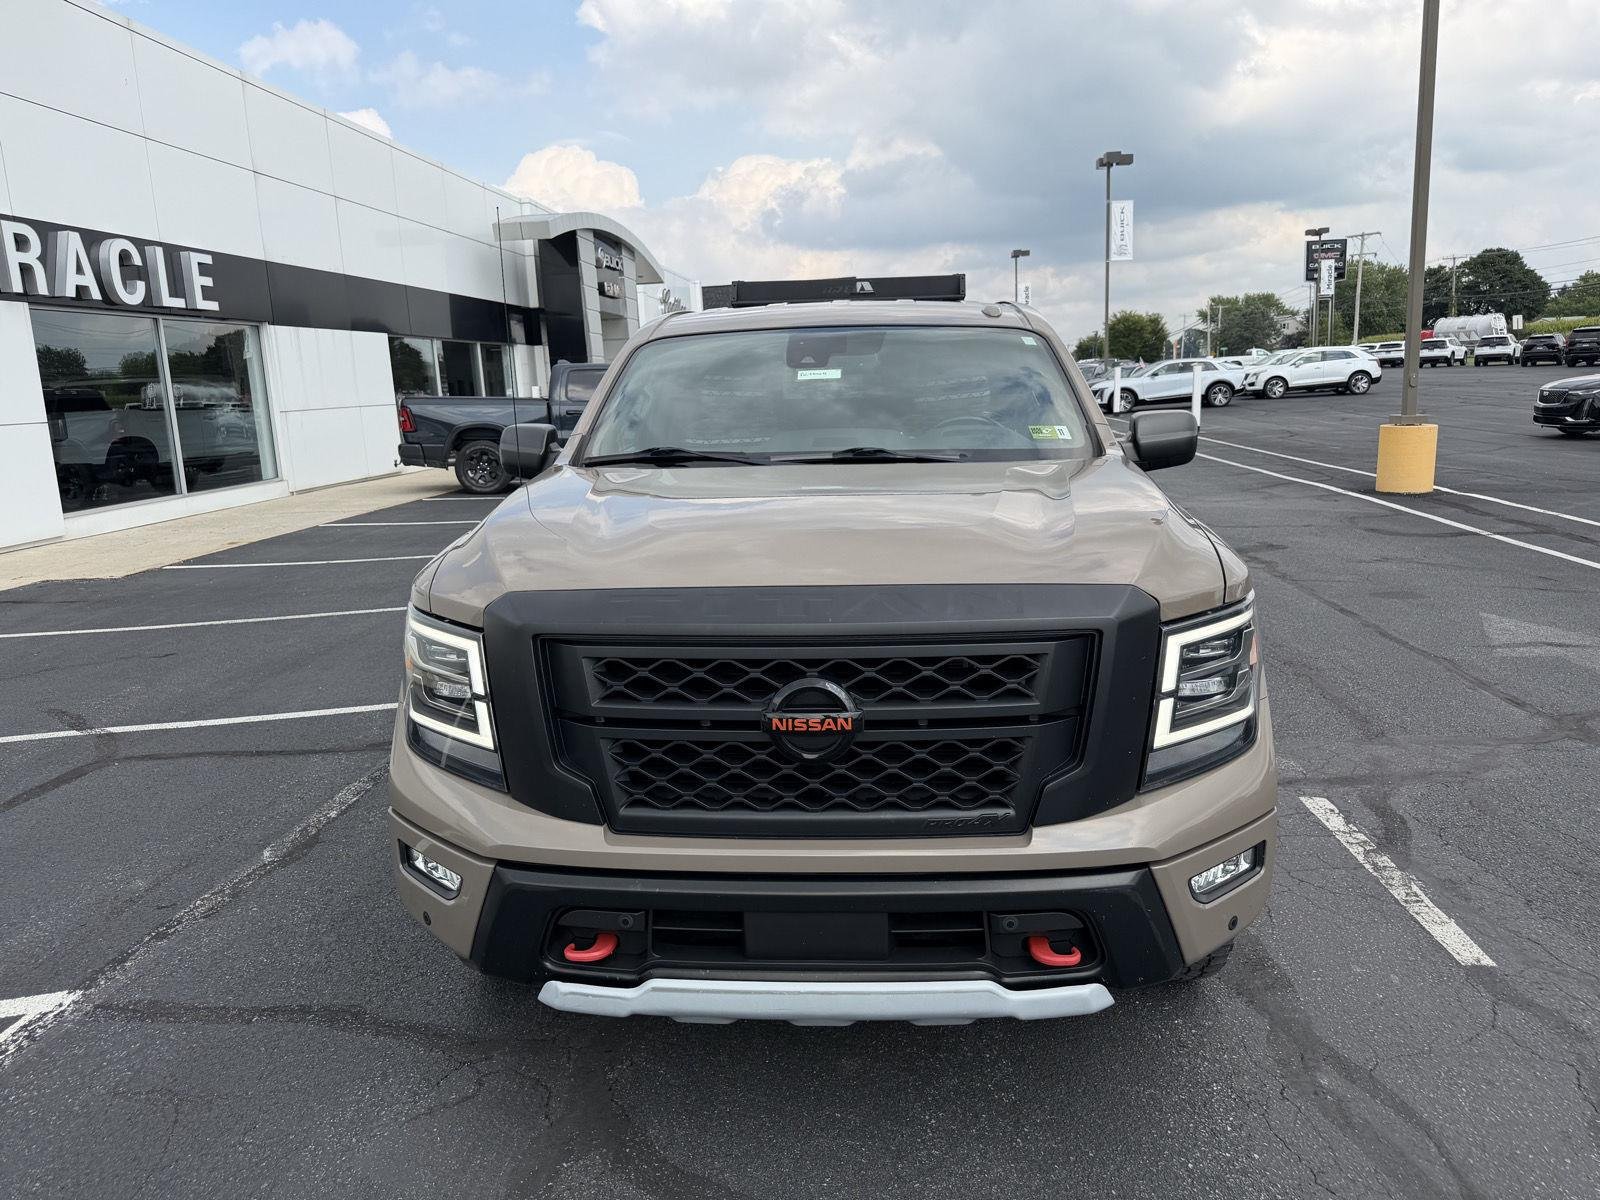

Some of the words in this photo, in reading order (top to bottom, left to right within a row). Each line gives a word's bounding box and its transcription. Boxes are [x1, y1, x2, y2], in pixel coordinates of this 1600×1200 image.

[0, 219, 220, 312] RACLE
[604, 253, 624, 271] BUICK
[771, 717, 853, 732] NISSAN
